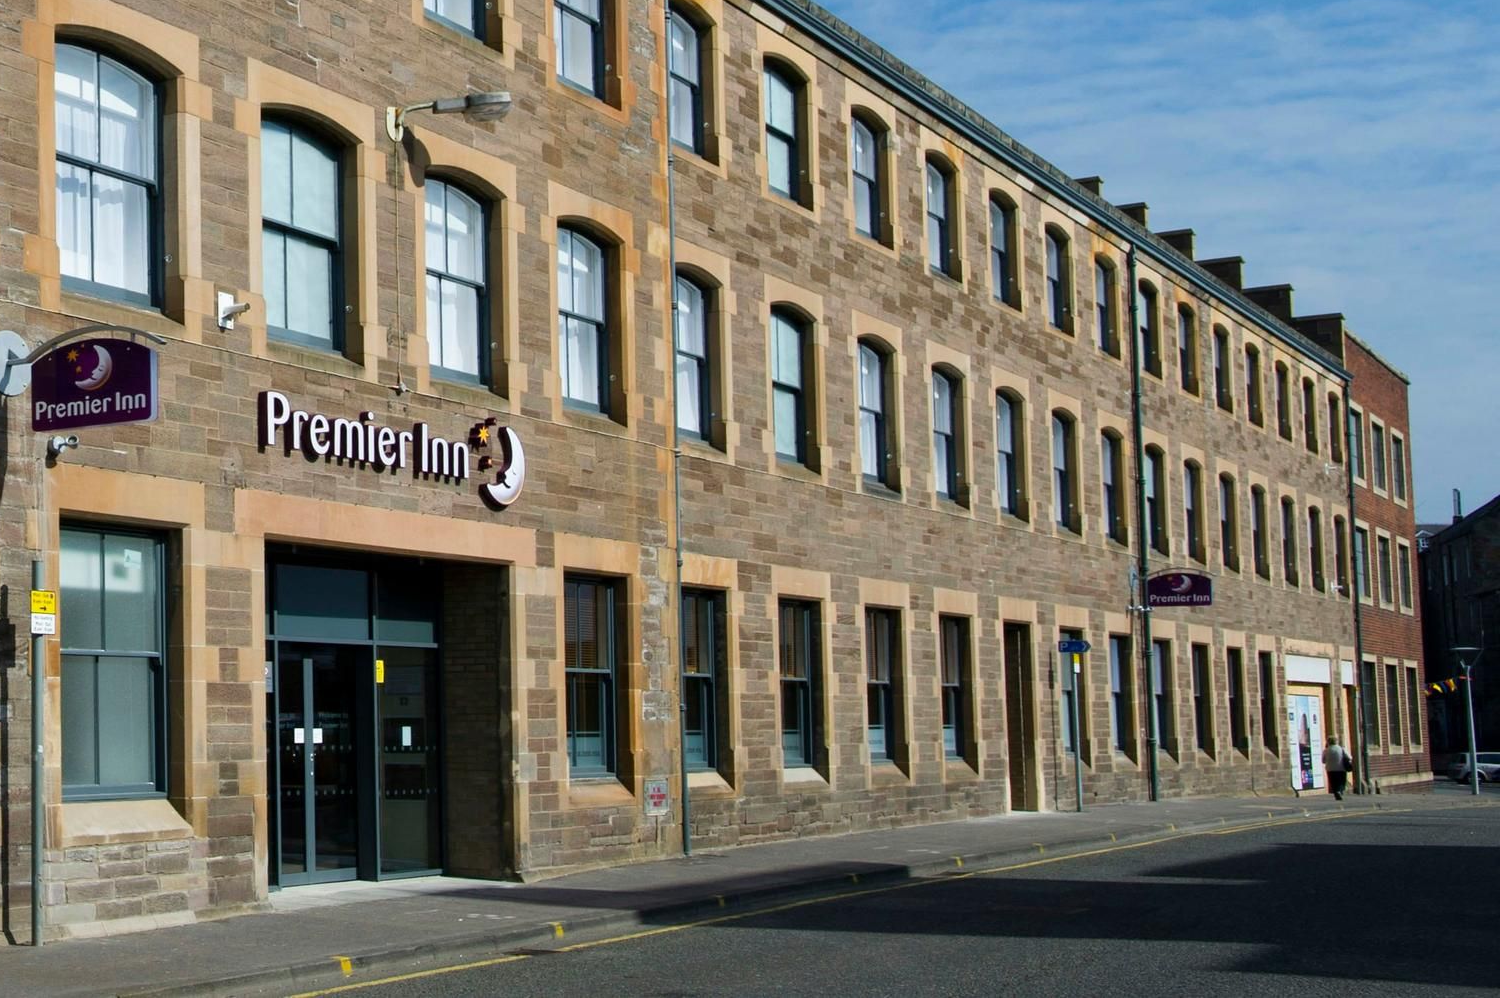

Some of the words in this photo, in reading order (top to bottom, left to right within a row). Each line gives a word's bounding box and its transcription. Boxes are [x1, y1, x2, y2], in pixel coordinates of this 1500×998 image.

[35, 395, 112, 421] Premier
[115, 391, 146, 411] Inn
[266, 390, 414, 468] Premier
[421, 422, 469, 479] Inn
[1150, 594, 1192, 603] Premier
[1193, 593, 1210, 602] Inn
